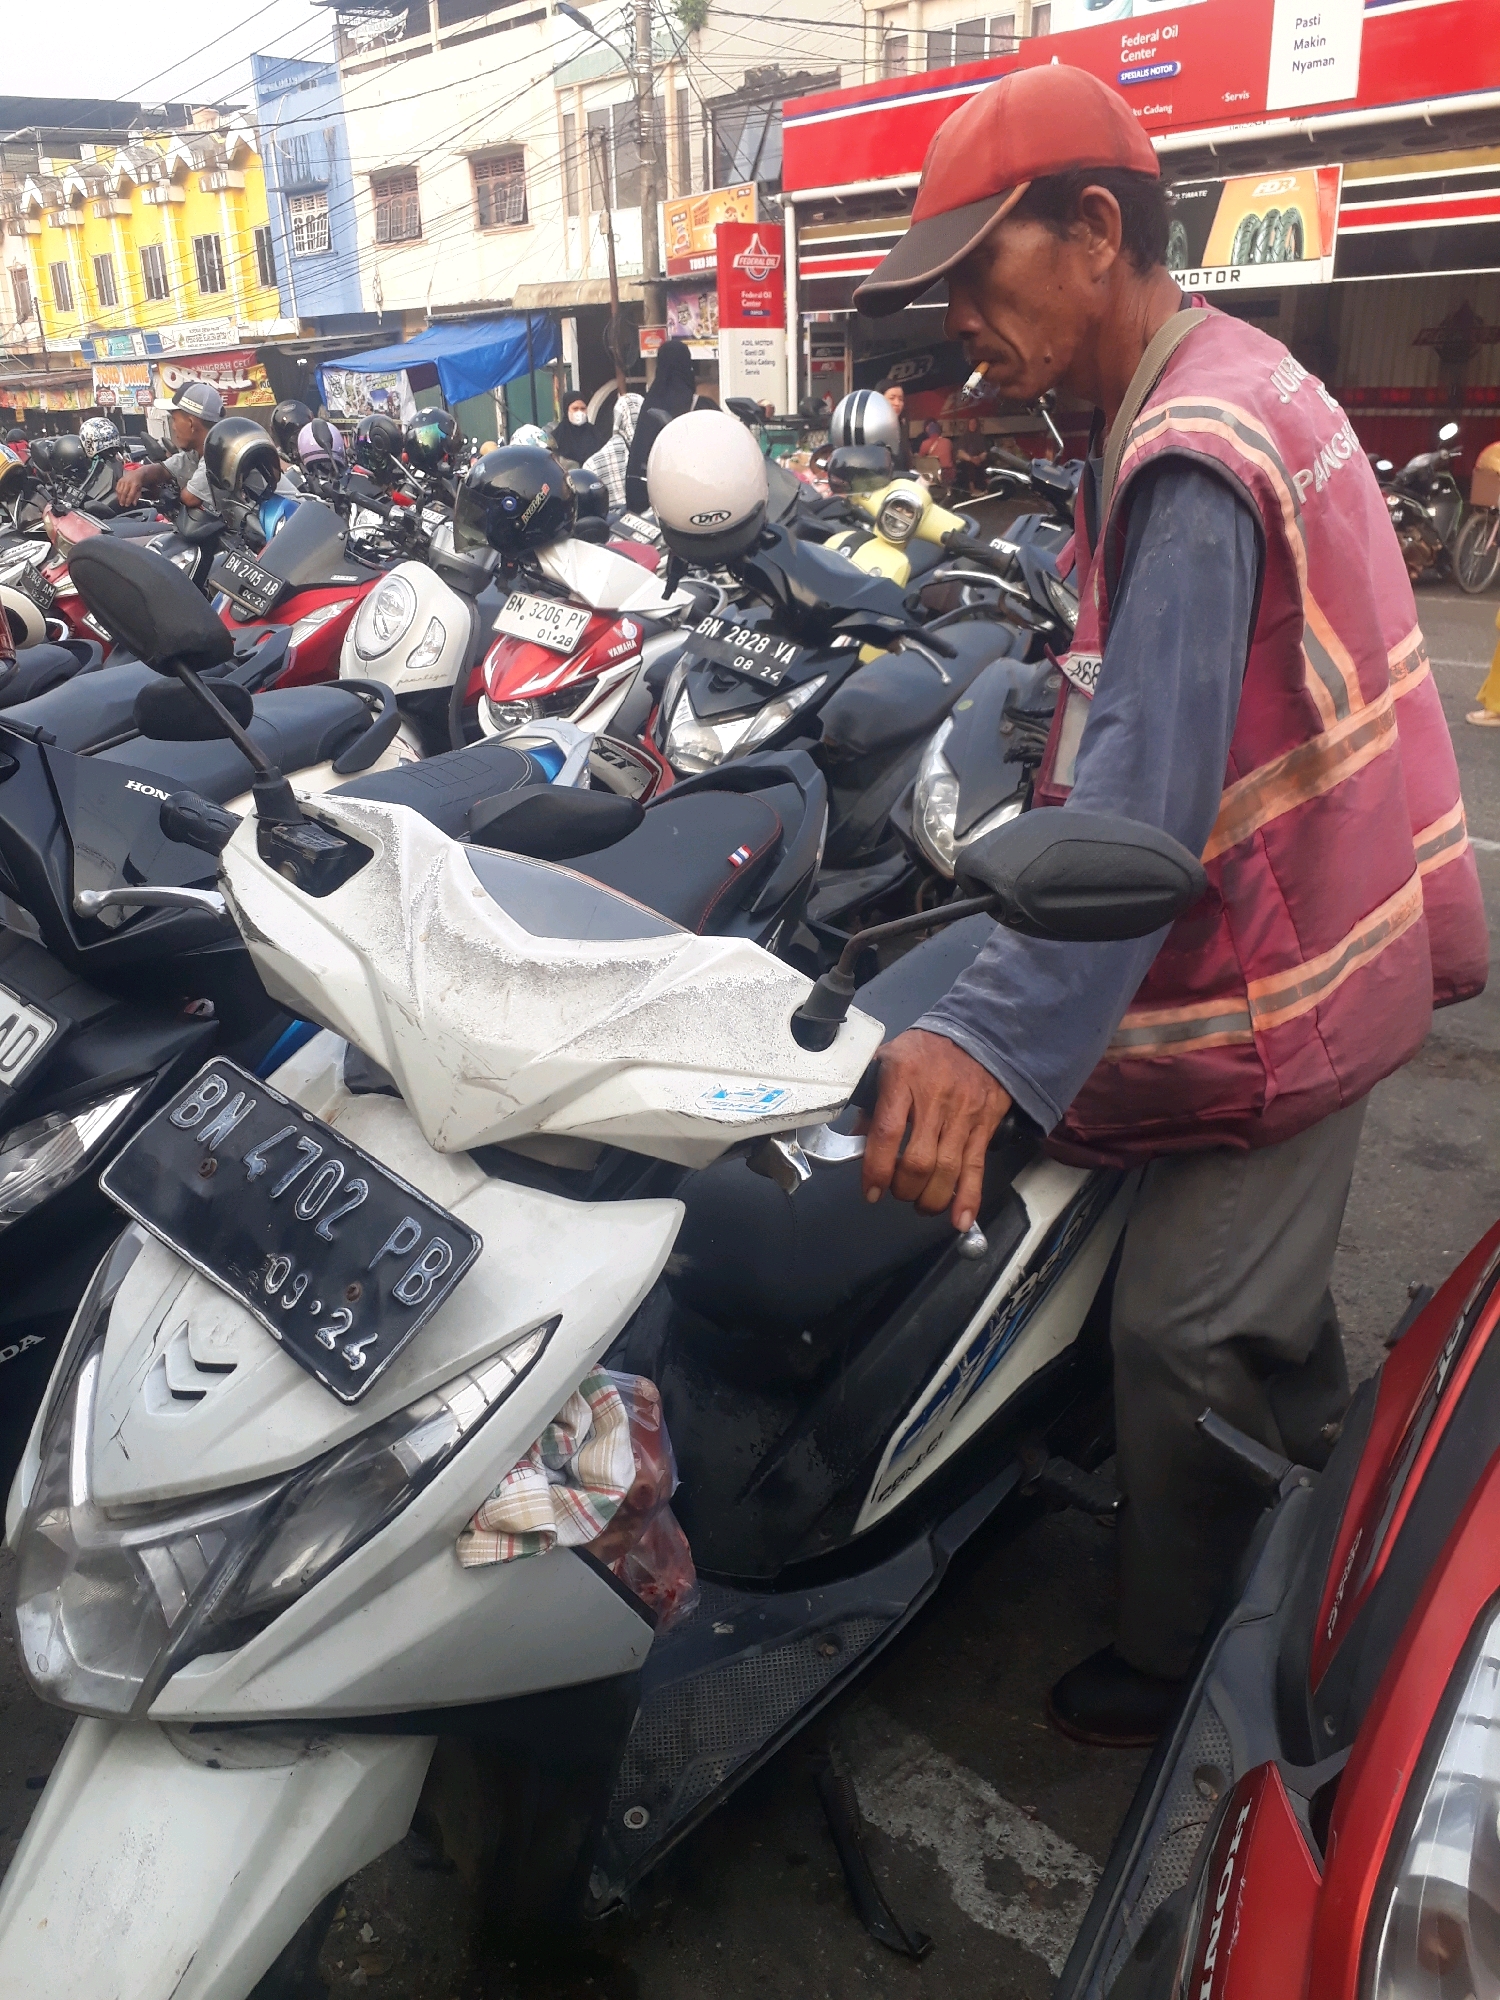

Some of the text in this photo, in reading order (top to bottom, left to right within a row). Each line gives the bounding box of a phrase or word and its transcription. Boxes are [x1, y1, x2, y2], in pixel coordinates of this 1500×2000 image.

[1295, 14, 1321, 29] Pasti
[1121, 24, 1179, 48] Federal Oil
[1293, 35, 1326, 51] Makin
[1121, 47, 1157, 63] Center
[1121, 64, 1173, 81] SPESIALIS MOTOR
[1292, 57, 1335, 74] Nyaman
[1224, 90, 1250, 102] Servis
[1143, 104, 1173, 115] Cadang
[739, 256, 777, 266] FEDERAL OIL
[1174, 269, 1241, 286] MOTOR
[741, 291, 772, 299] Federal Oil
[741, 299, 761, 307] Center
[42, 583, 55, 597] AM
[262, 580, 278, 596] AB
[506, 594, 587, 630] BN 3206 PY
[608, 640, 637, 658] YAMAHA
[695, 617, 797, 664] BN 2828 VA
[733, 656, 782, 681] 08 24
[125, 779, 172, 801] HON
[169, 1073, 453, 1307] BN 4702 PB
[1200, 1796, 1253, 2000] HON
